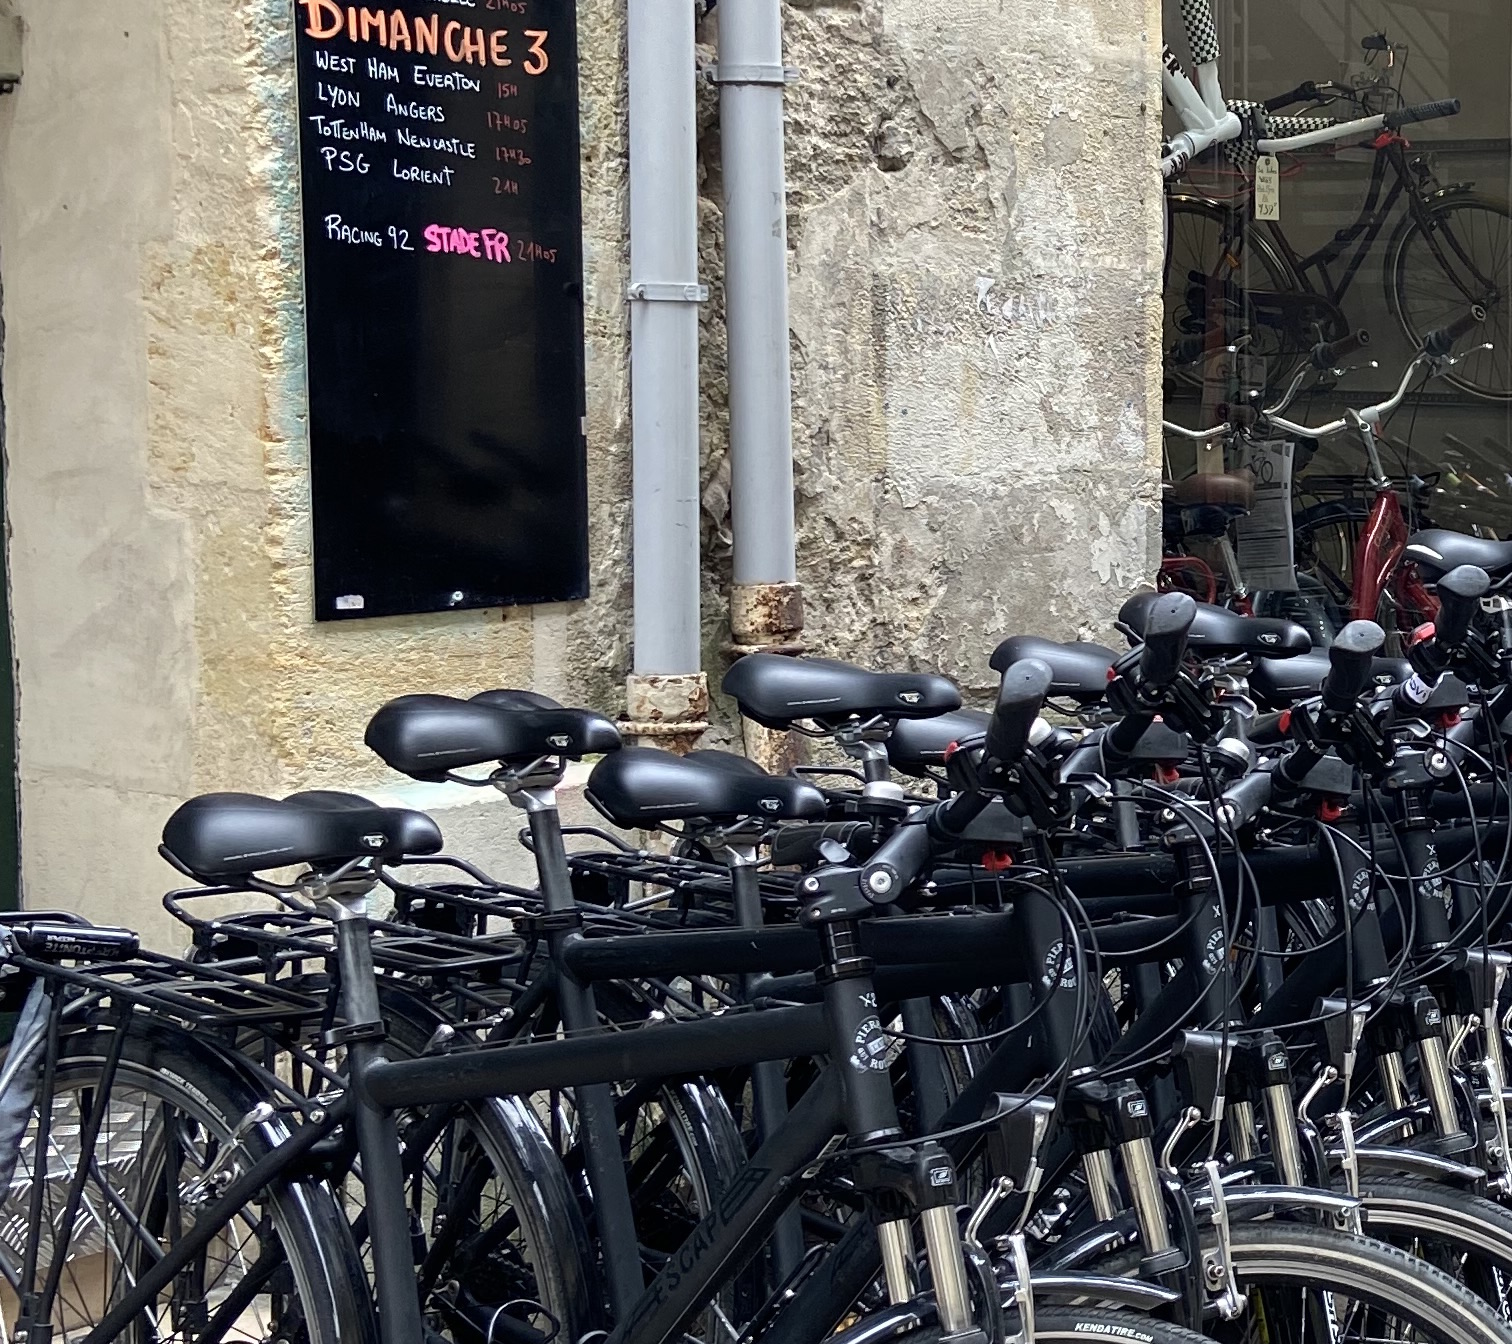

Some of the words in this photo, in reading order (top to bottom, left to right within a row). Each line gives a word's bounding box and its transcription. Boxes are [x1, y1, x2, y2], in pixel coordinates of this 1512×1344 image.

[315, 50, 357, 74] WEST
[367, 57, 400, 84] HAM
[522, 30, 549, 76] 3
[318, 82, 361, 109] LYON
[386, 93, 445, 123] ANGERS
[320, 146, 371, 174] PSG
[325, 213, 383, 247] RACING
[387, 225, 415, 252] 92
[1074, 1322, 1154, 1343] KENDATIRE.COM
